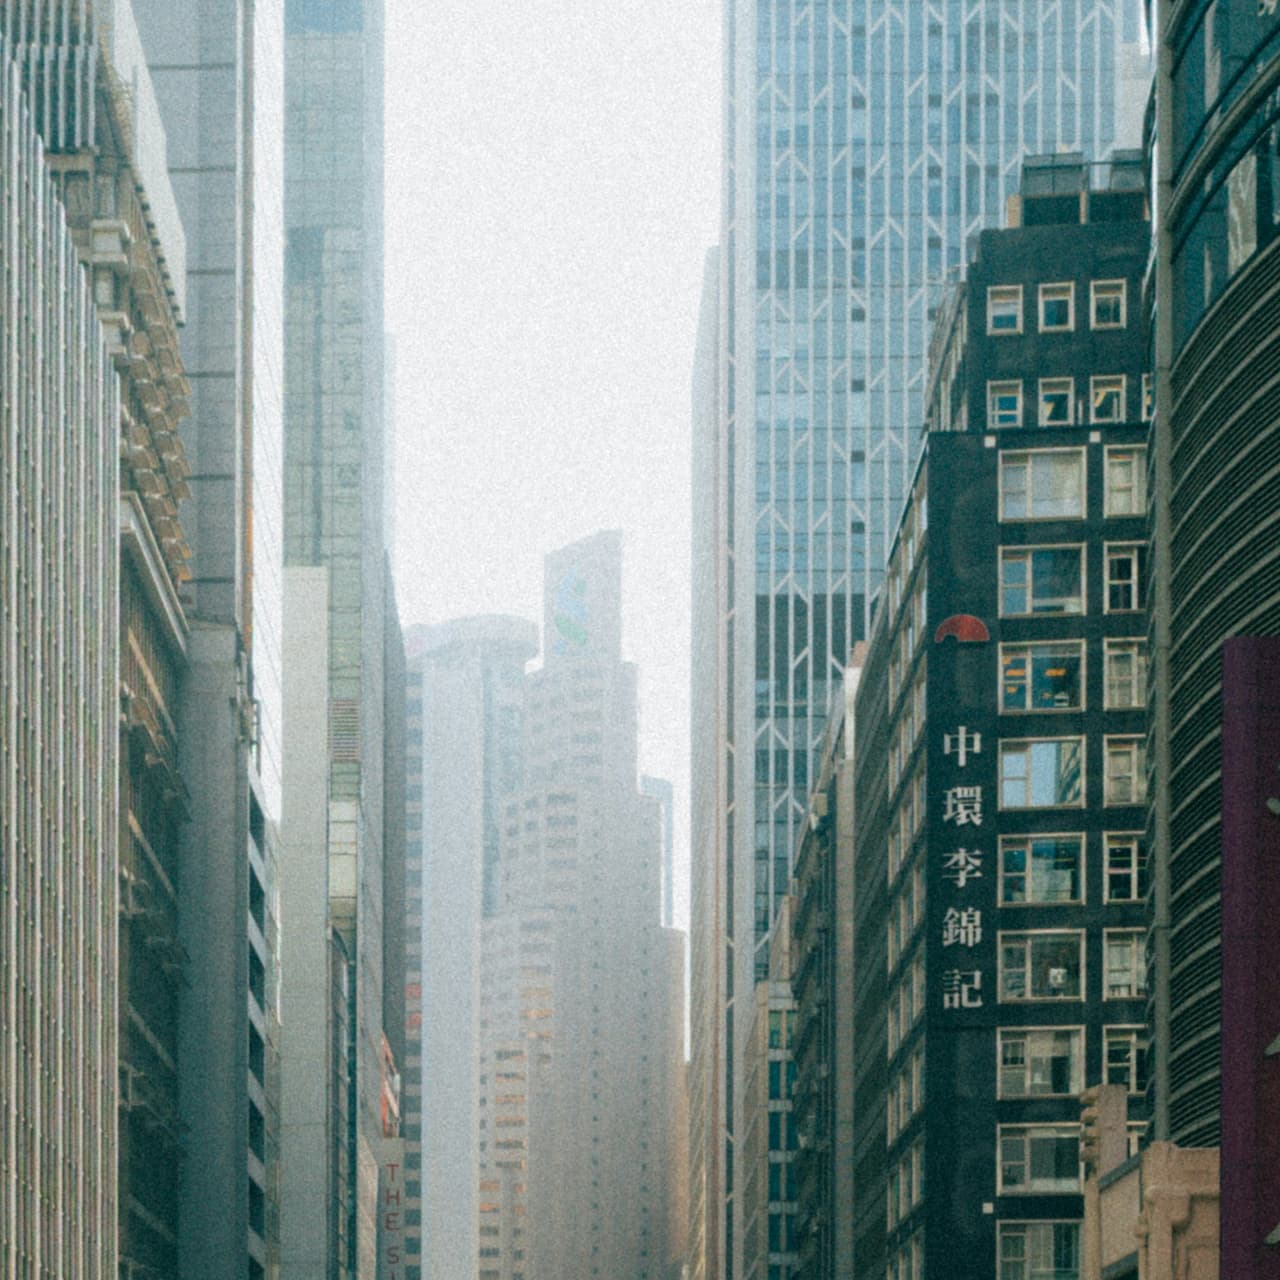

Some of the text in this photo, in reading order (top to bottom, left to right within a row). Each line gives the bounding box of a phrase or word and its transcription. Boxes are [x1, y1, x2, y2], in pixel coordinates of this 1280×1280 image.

[942, 725, 984, 1010] 中環李錦記
[384, 1164, 400, 1233] THE
